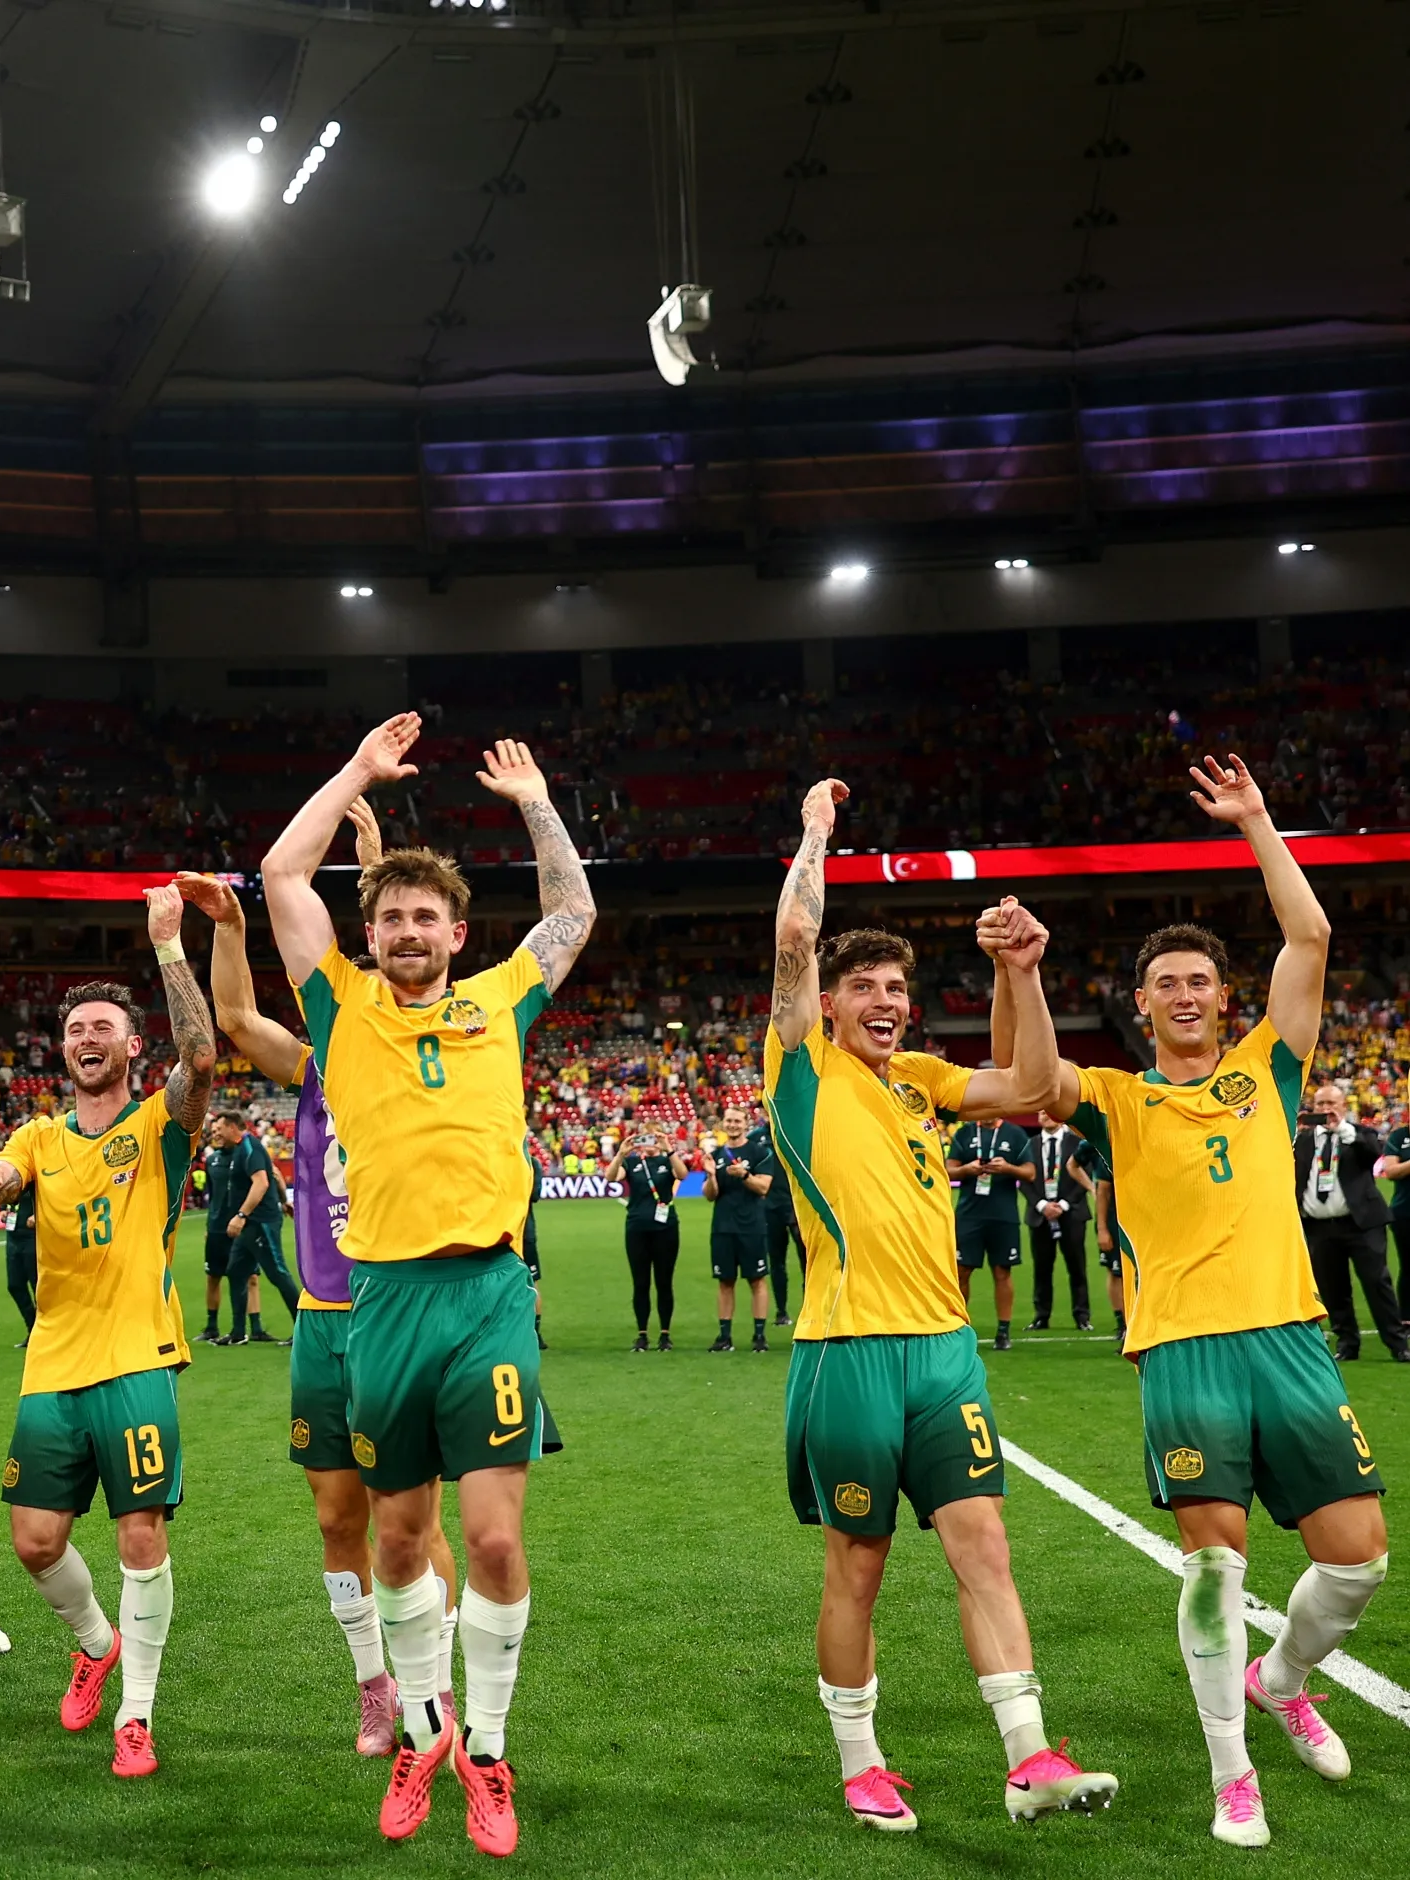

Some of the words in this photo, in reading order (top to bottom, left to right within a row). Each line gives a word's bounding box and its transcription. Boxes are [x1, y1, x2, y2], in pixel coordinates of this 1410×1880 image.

[417, 1034, 445, 1088] 8
[1206, 1135, 1233, 1184] 3
[75, 1196, 112, 1249] 13
[492, 1363, 523, 1425] 8
[124, 1424, 165, 1478] 13
[960, 1403, 993, 1458] 5
[1338, 1405, 1371, 1458] 3
